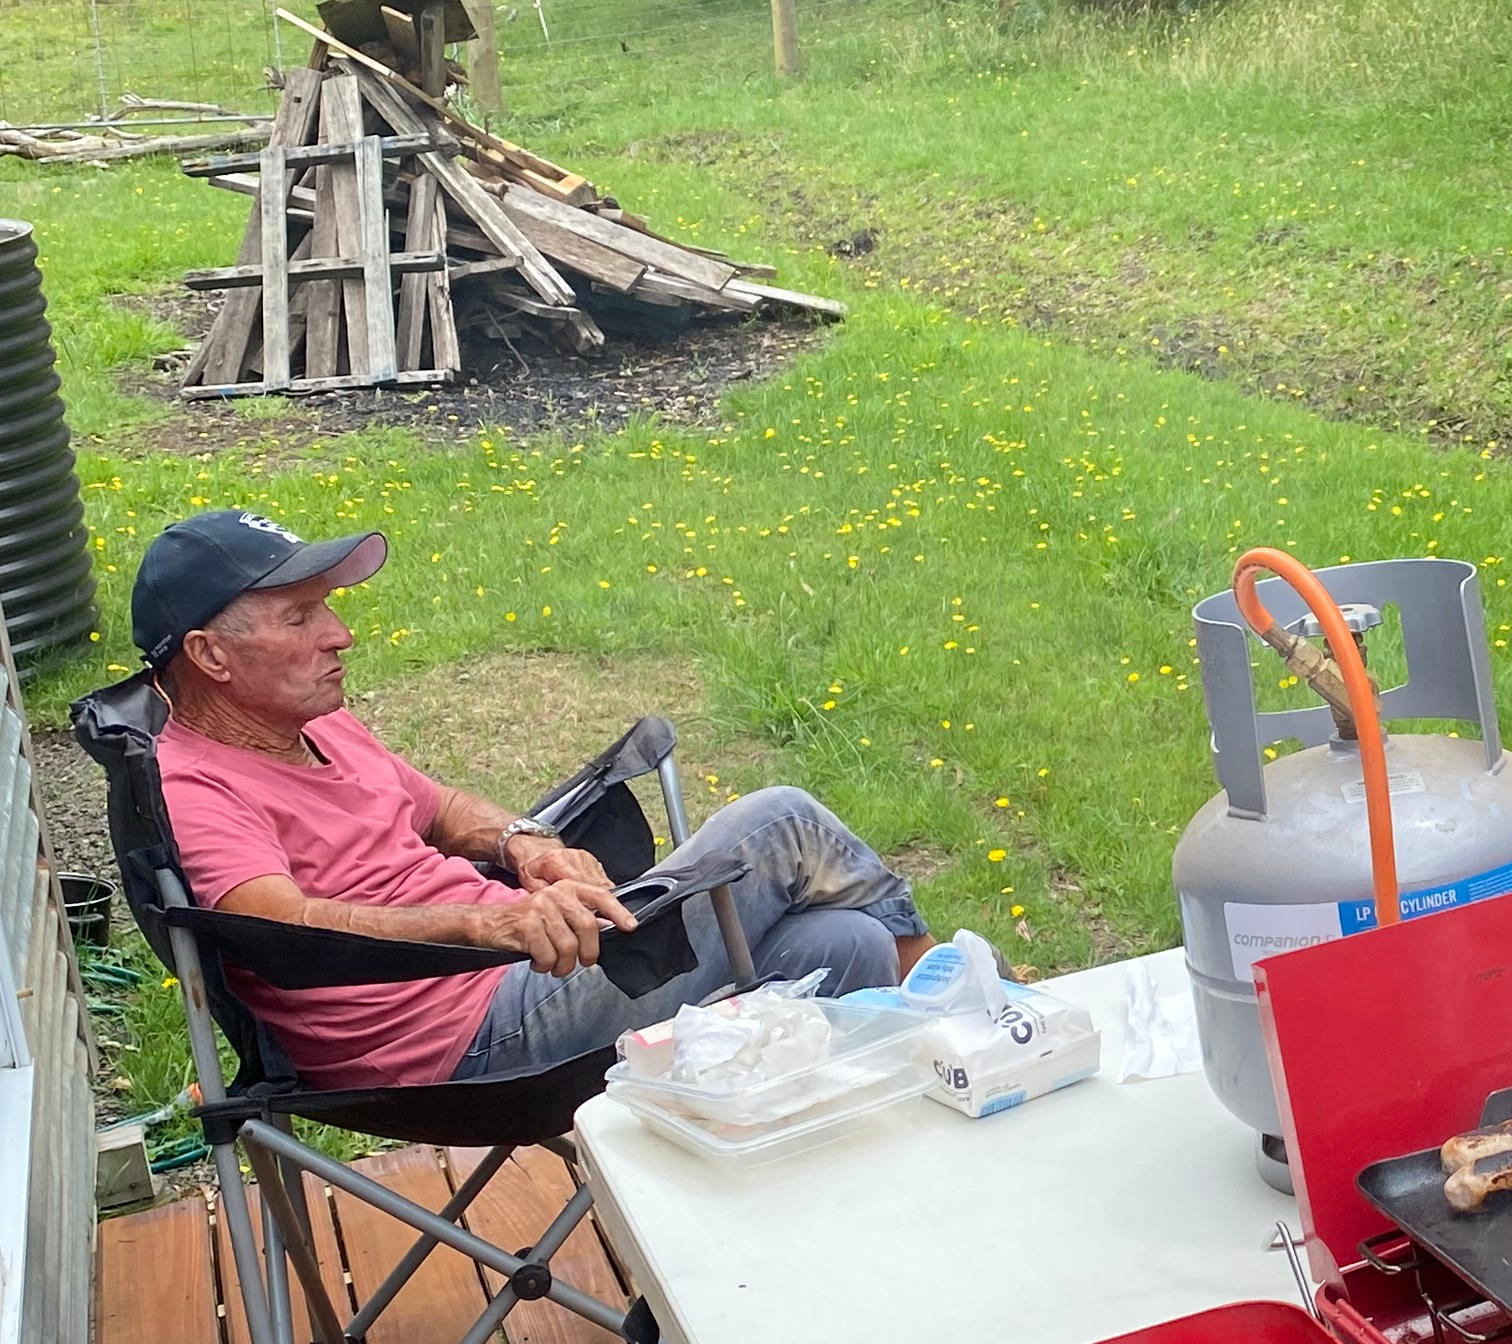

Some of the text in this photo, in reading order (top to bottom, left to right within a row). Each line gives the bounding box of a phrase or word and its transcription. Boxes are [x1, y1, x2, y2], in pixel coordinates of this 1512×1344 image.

[1355, 889, 1458, 922] LP CYLINDER
[1233, 933, 1323, 949] companion
